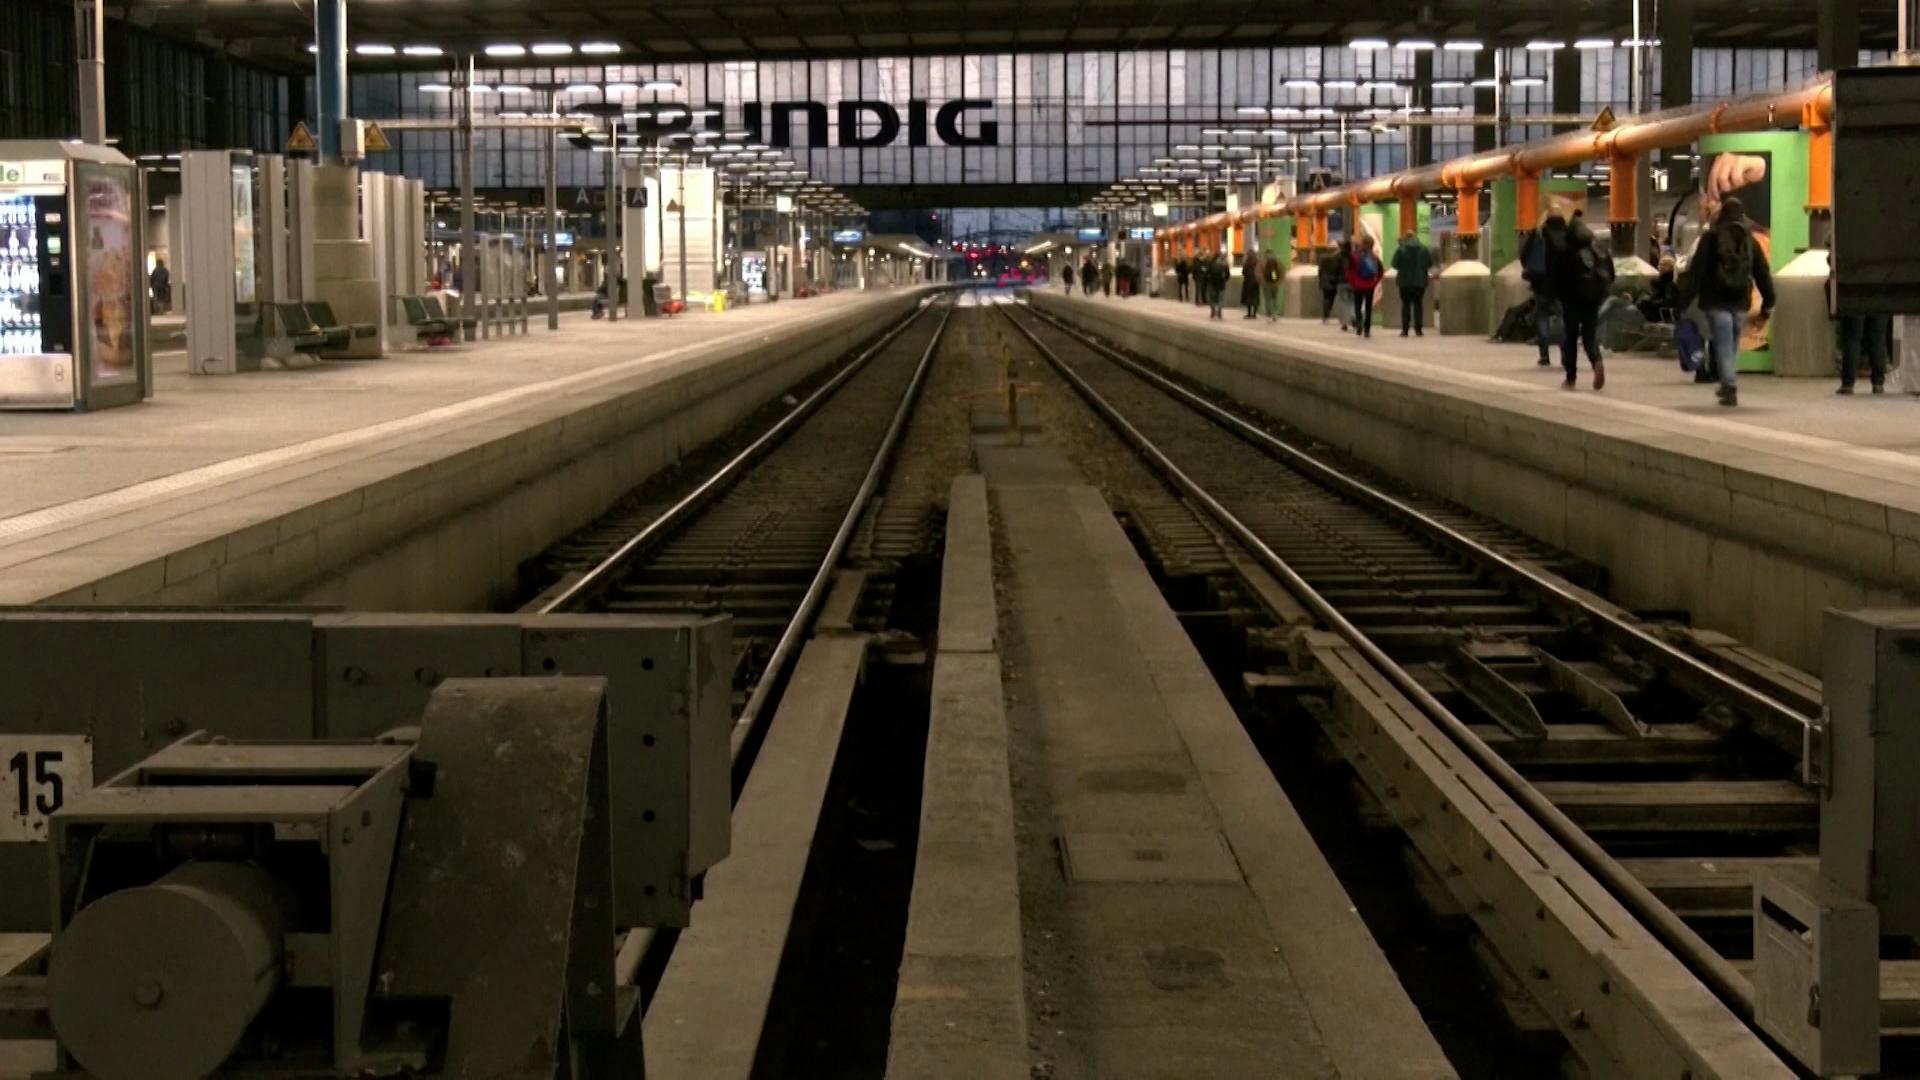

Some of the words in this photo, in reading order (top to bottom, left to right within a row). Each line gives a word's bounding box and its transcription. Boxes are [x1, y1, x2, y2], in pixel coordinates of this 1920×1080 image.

[576, 186, 589, 204] A
[632, 188, 646, 204] A
[10, 751, 63, 816] 15
